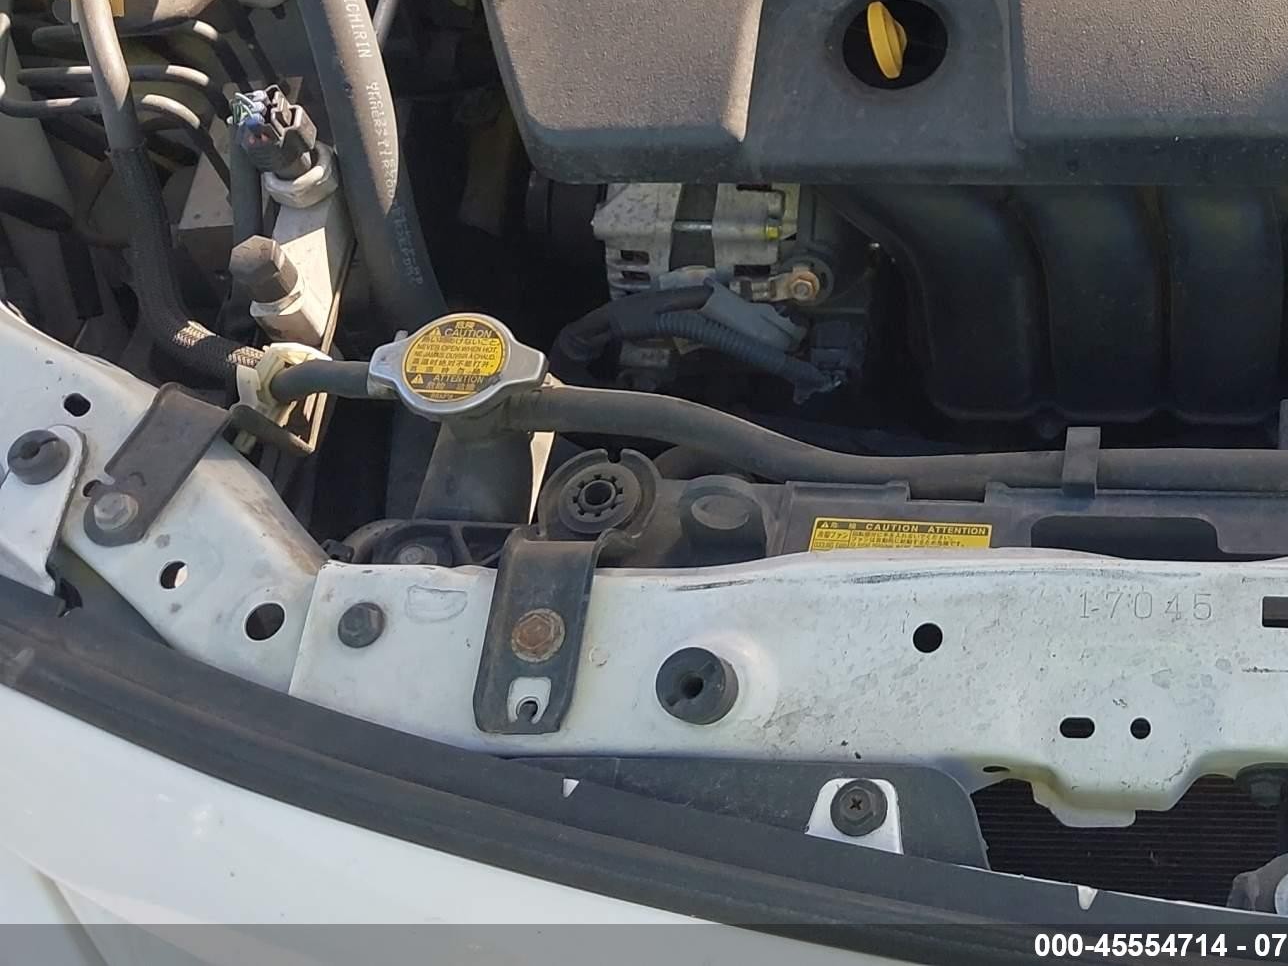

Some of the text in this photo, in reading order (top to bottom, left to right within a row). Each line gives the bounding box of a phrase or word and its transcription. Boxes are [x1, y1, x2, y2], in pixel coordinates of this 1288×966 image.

[444, 328, 492, 338] CAUTION
[417, 344, 440, 352] NEVER
[441, 344, 460, 352] OPEN
[433, 374, 484, 384] ATTENTION
[865, 523, 918, 532] CAUTION
[927, 526, 987, 535] ATTENTION
